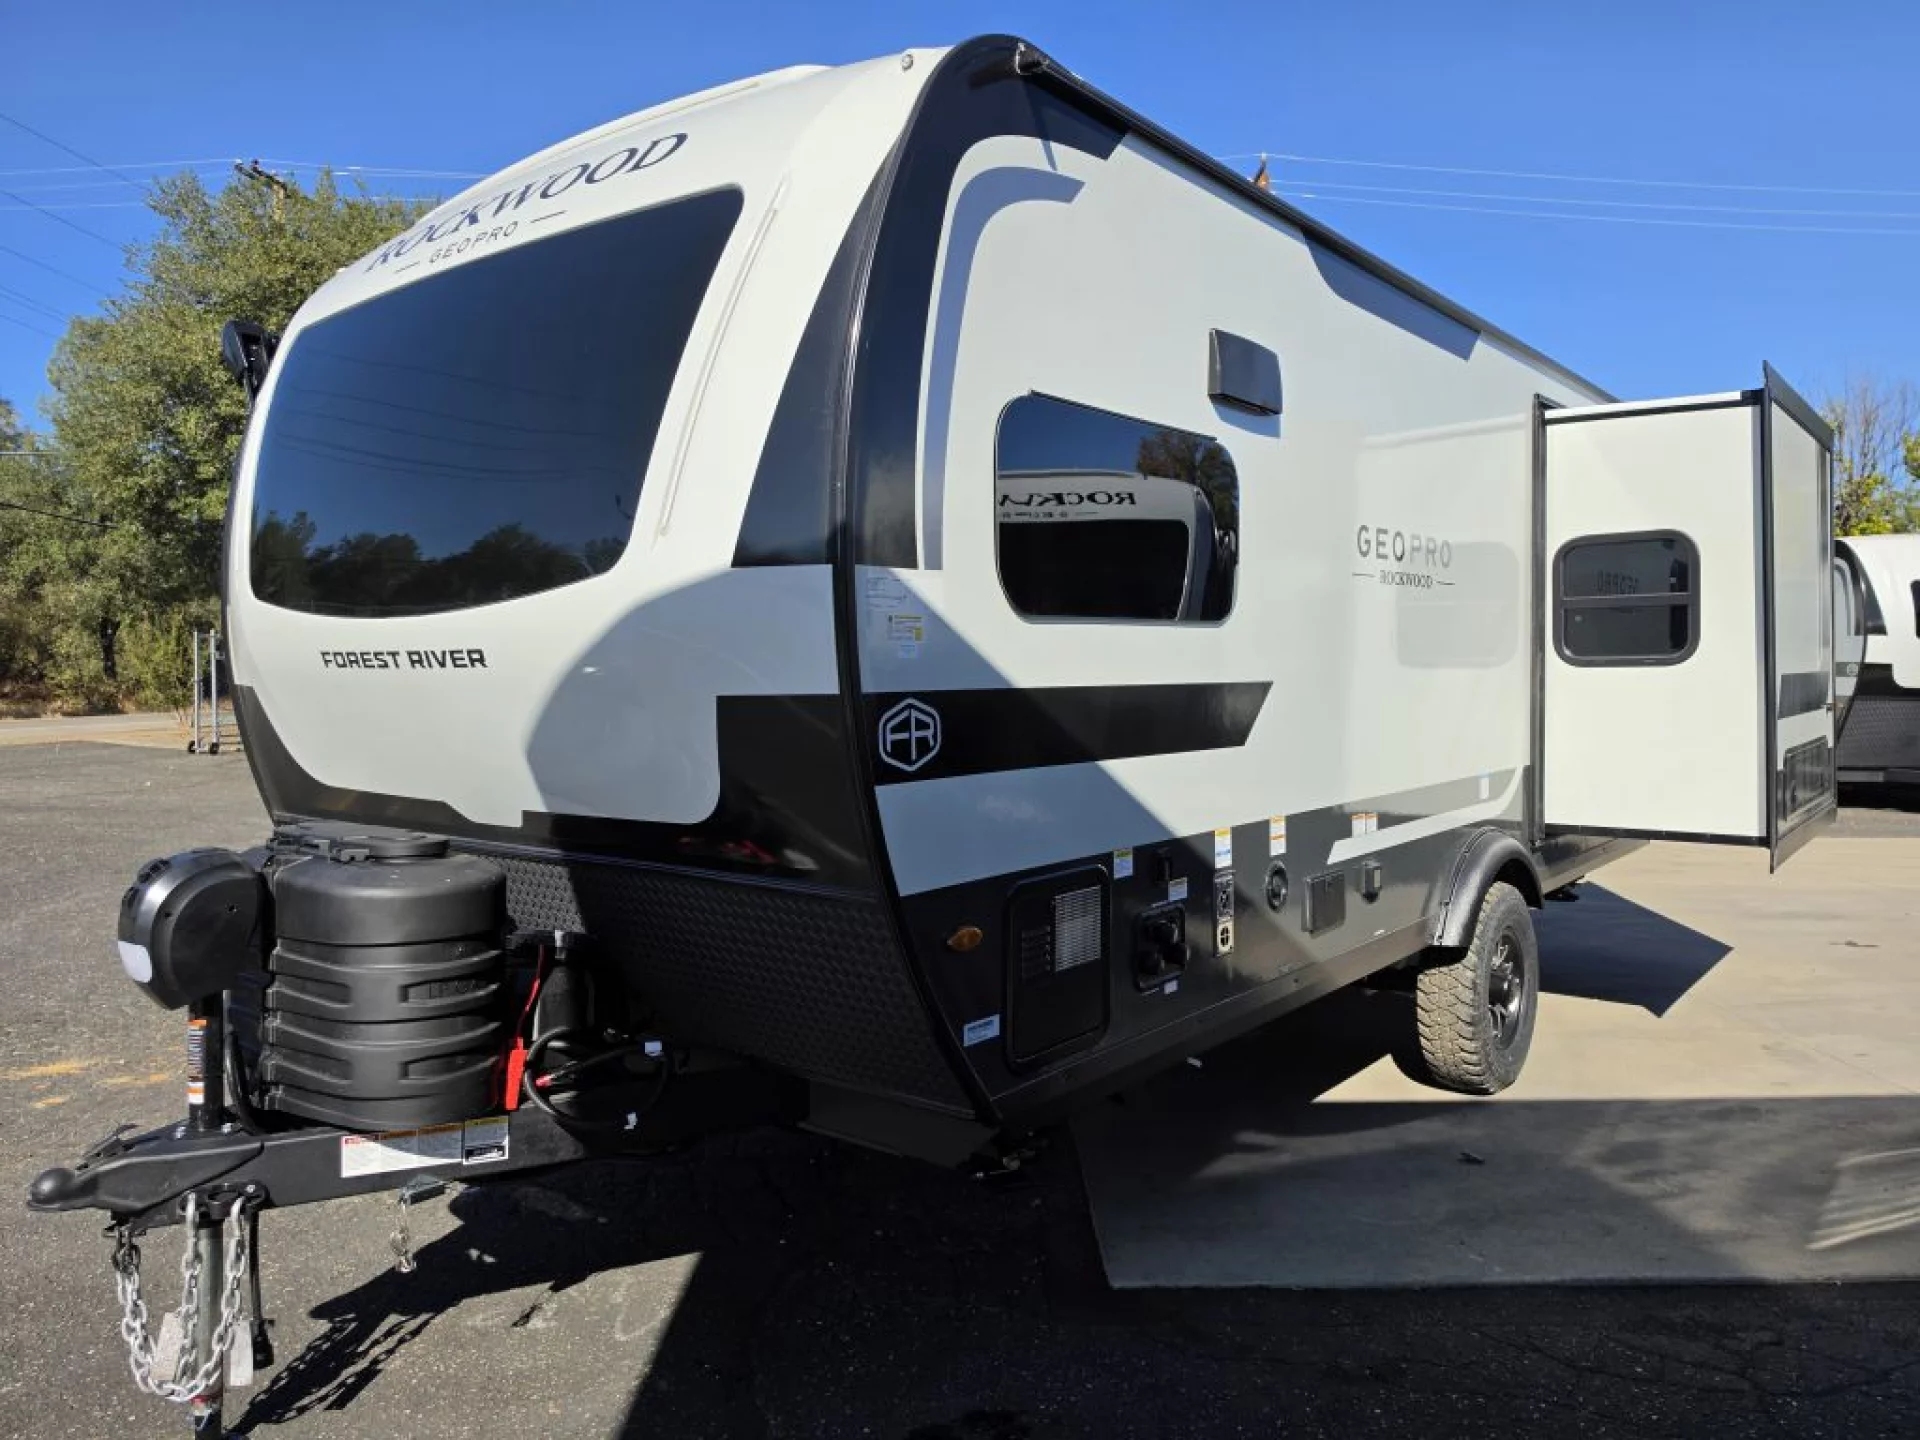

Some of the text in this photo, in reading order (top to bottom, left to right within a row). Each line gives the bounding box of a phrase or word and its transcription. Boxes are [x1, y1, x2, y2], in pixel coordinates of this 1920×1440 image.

[364, 132, 688, 272] ROCKWOOD
[428, 220, 519, 264] GEOPRO
[1356, 524, 1452, 568] GEOPRO
[1379, 570, 1433, 589] ROCKWOOD
[320, 649, 488, 669] FOREST RIVER
